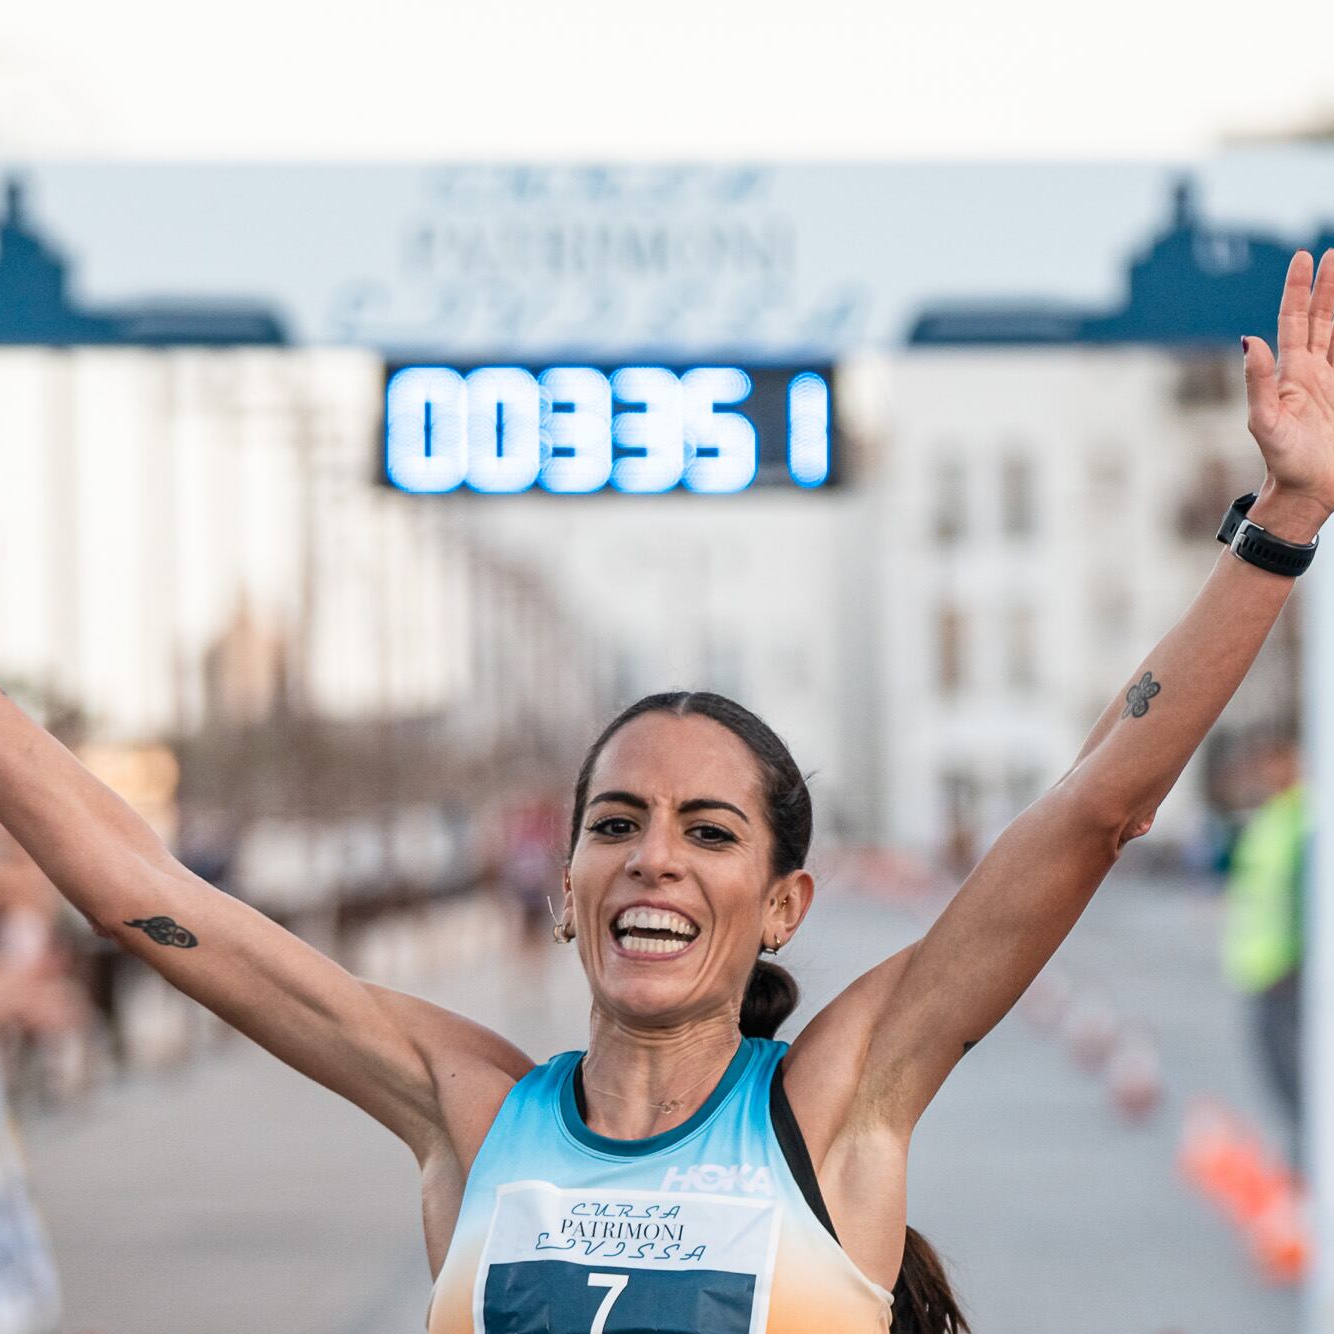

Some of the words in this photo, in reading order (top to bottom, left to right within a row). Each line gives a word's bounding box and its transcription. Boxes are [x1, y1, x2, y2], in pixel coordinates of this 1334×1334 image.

[660, 1163, 774, 1195] HOKA
[571, 1202, 683, 1219] CURSA
[560, 1216, 685, 1243] PATRIMONI
[535, 1232, 707, 1263] EIVISSA
